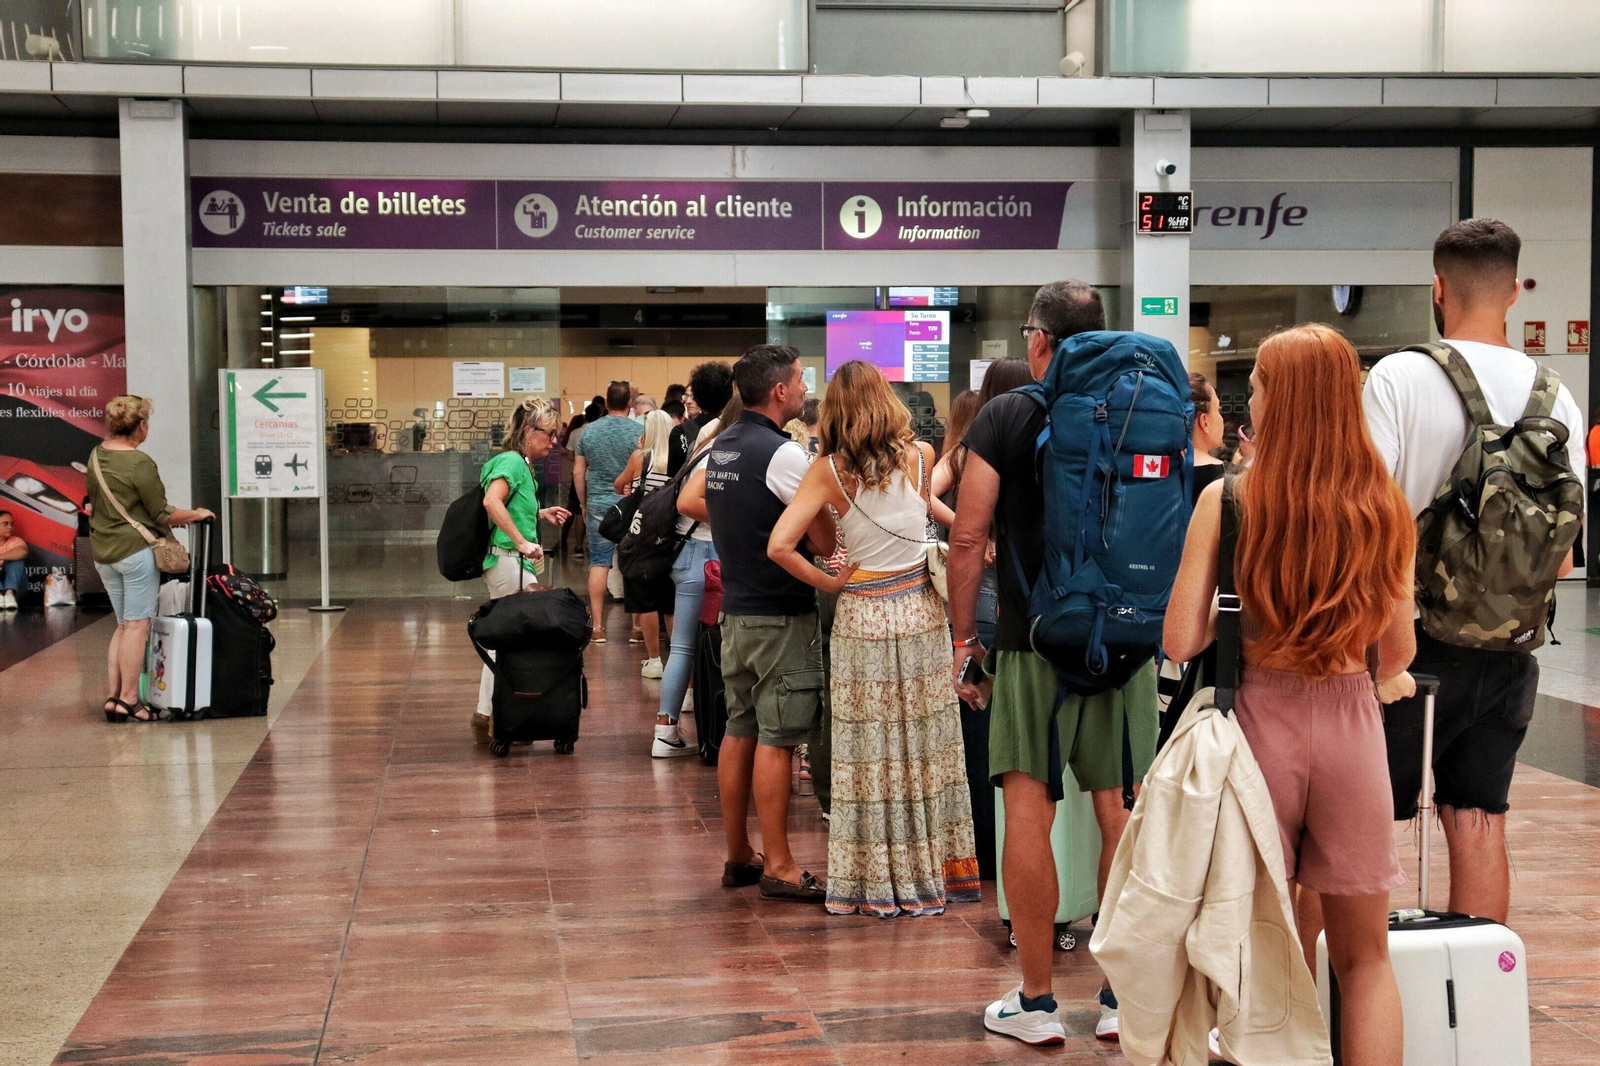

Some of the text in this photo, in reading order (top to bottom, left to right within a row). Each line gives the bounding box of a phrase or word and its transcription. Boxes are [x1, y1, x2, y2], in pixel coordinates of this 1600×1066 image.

[262, 191, 466, 216] Venta de billetes
[575, 193, 793, 218] Atención al cliente
[897, 194, 1032, 218] Información
[1141, 195, 1153, 210] 2
[1142, 214, 1189, 229] 51 %HR
[1193, 192, 1308, 240] renfe
[262, 221, 347, 238] Tickets sale
[574, 224, 696, 240] Customer service
[898, 225, 980, 241] Information
[10, 297, 89, 342] iryo
[340, 309, 350, 323] 6
[489, 309, 498, 323] 5
[633, 309, 643, 323] 4
[963, 309, 973, 323] 2
[15, 352, 86, 368] Córdoba
[7, 382, 98, 398] 10 viajes al día
[16, 407, 64, 418] flexibles
[68, 406, 103, 418] desde
[254, 419, 299, 429] Cercanías
[706, 470, 740, 482] TON MARTIN
[707, 480, 725, 491] RACING
